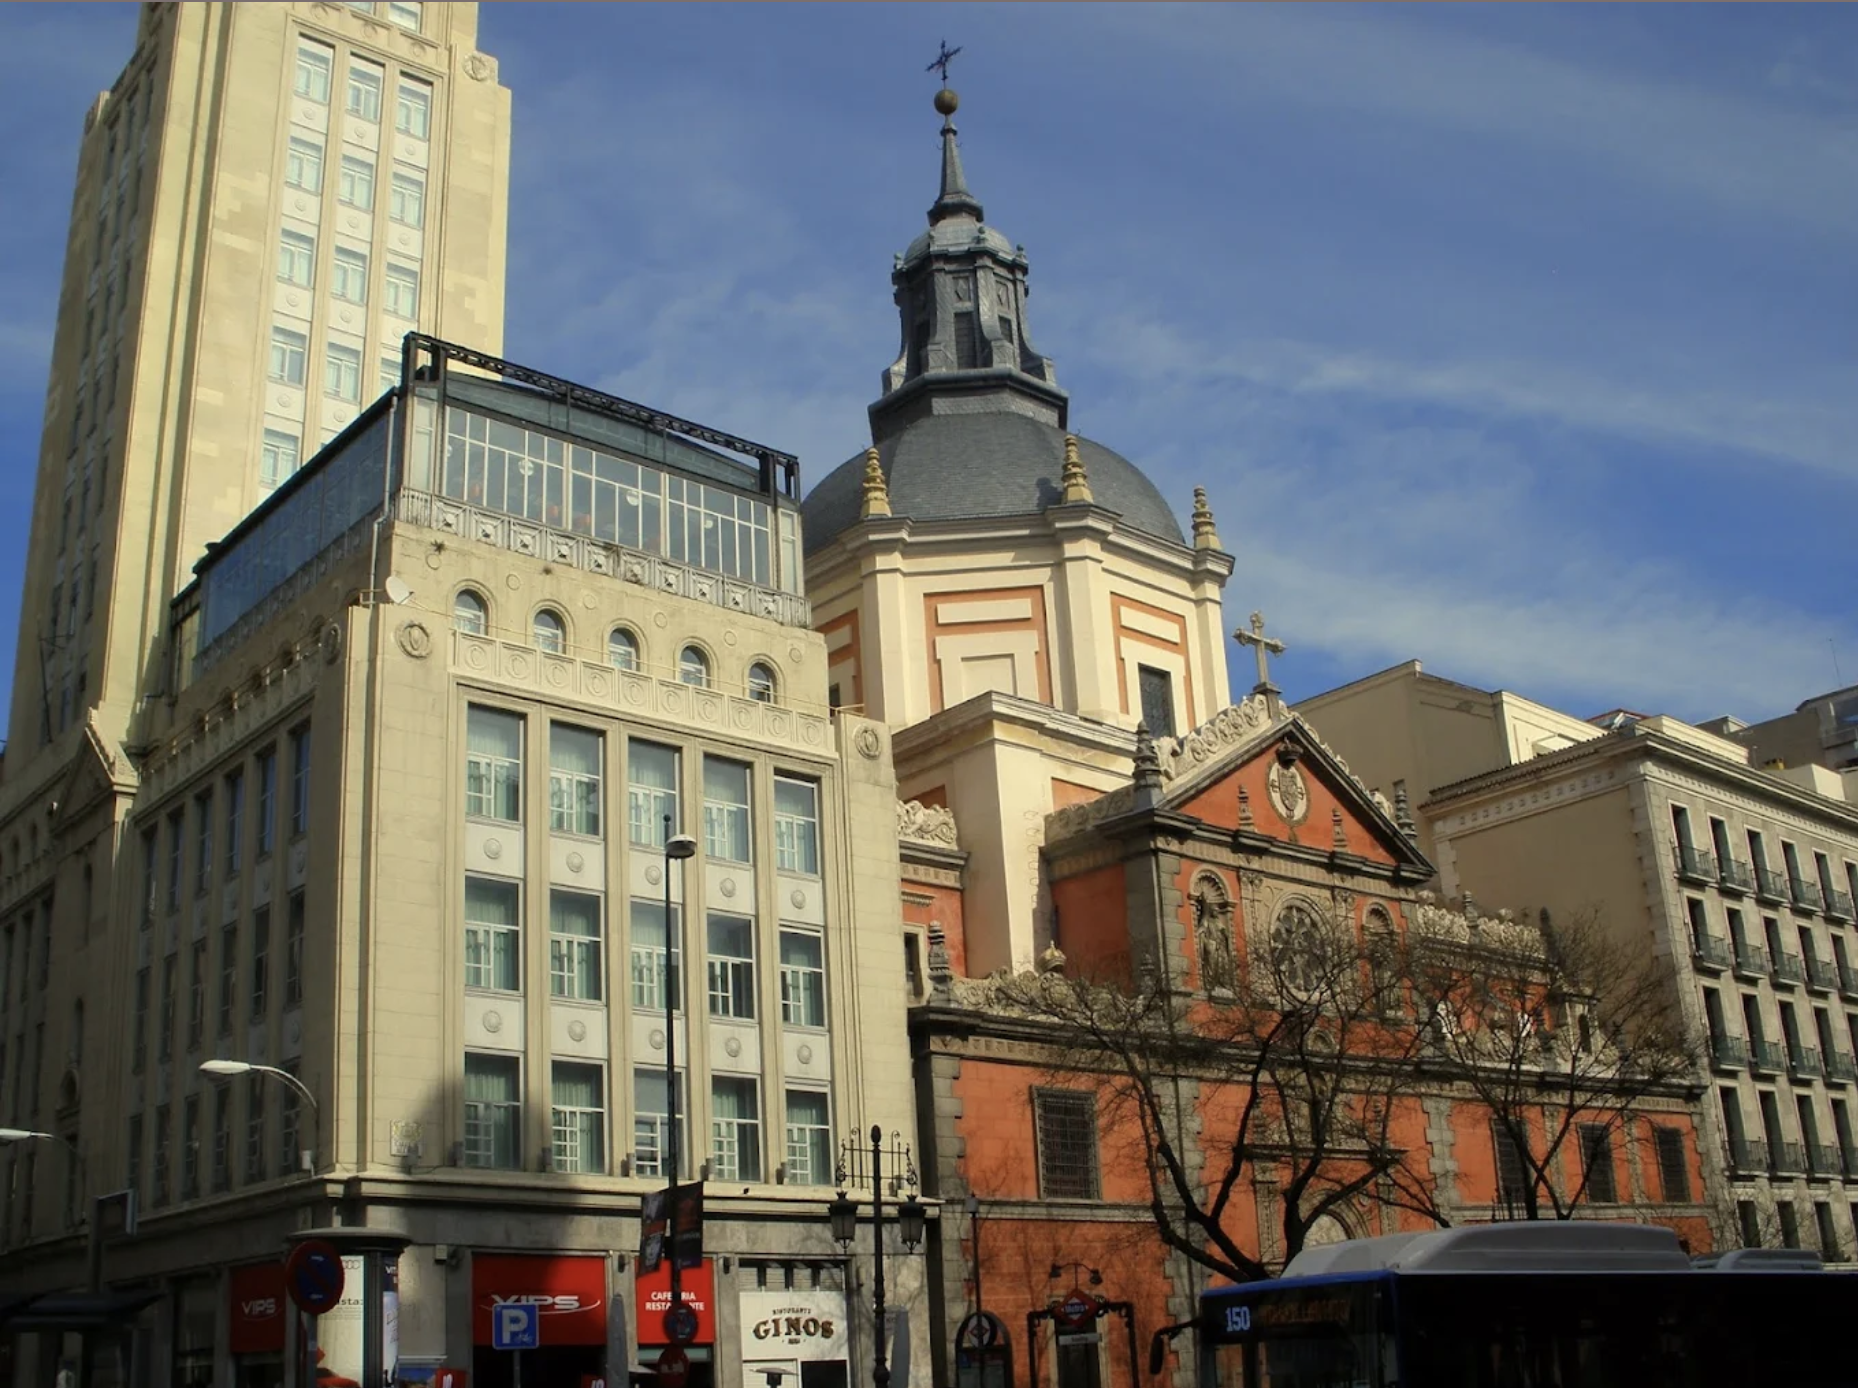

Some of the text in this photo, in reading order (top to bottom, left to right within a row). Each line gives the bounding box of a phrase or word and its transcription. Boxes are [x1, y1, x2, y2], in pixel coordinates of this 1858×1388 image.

[645, 1301, 705, 1311] RESTANTE
[651, 1291, 696, 1301] CAFERIA
[241, 1298, 276, 1315] VIPS
[502, 1309, 529, 1344] P
[753, 1316, 834, 1340] GINOS
[1225, 1306, 1251, 1332] 150
